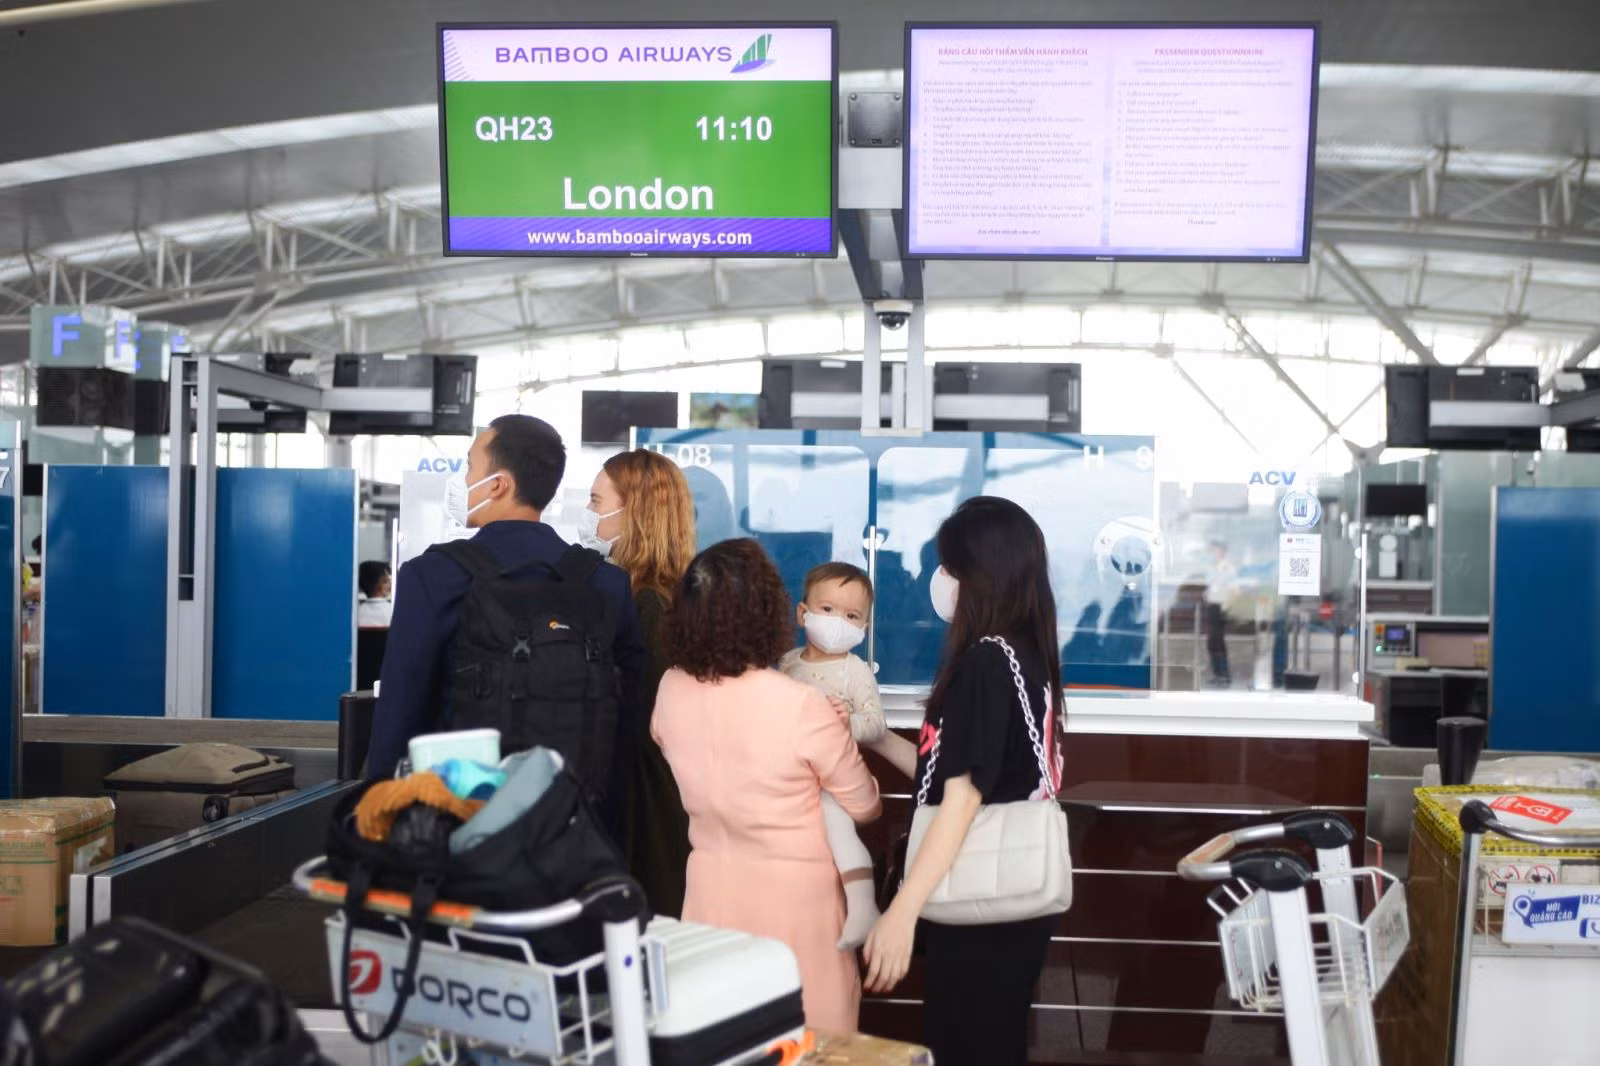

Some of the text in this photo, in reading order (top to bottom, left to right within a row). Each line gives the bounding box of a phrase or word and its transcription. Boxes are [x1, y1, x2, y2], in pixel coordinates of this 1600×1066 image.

[495, 46, 732, 64] BAMBOO AIRWAYS
[1154, 48, 1264, 56] PASSENGER QUESTIONNAIRE
[475, 116, 553, 142] QH23
[695, 116, 772, 141] 11:10
[563, 177, 714, 210] London
[527, 229, 752, 248] www.bambooairways.com
[52, 315, 82, 357] F
[417, 457, 463, 473] ACV
[1248, 471, 1297, 486] ACV
